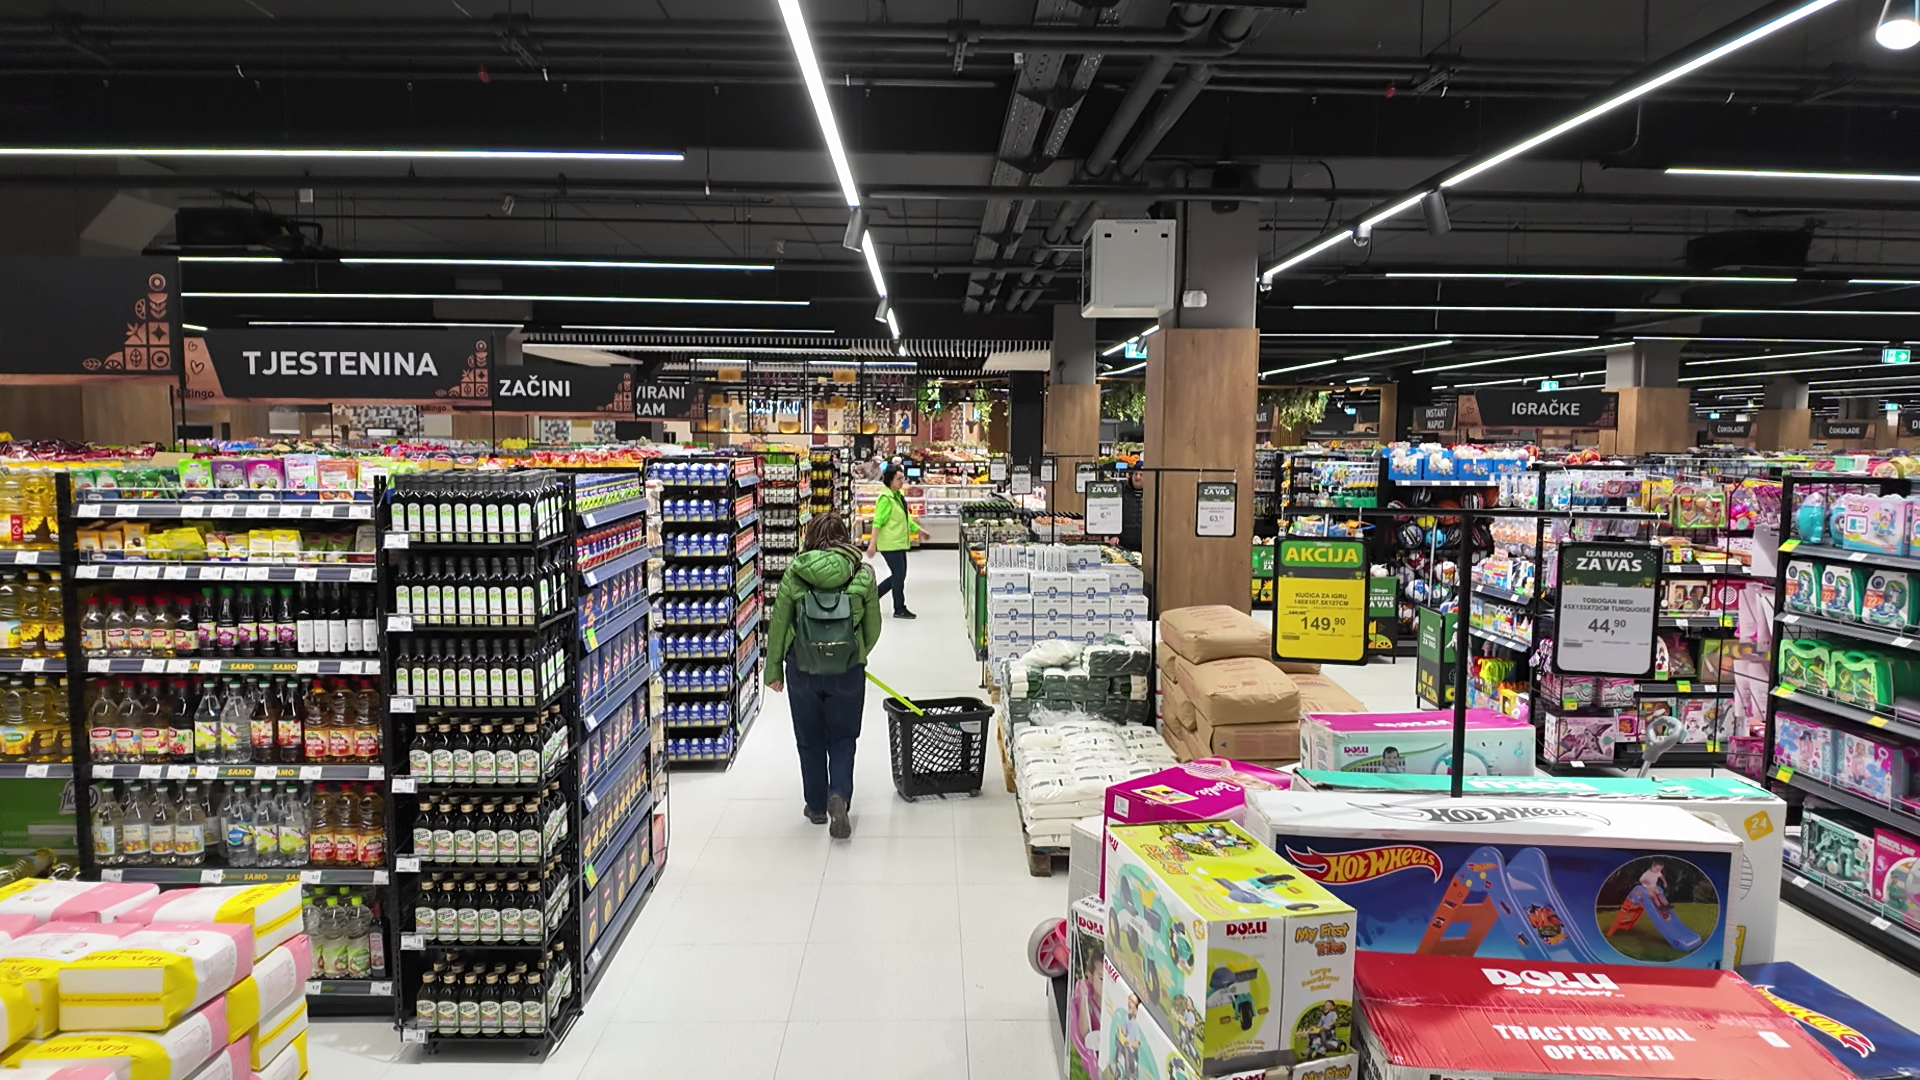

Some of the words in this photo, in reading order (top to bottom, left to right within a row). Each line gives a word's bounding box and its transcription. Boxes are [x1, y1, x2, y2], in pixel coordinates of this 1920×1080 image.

[242, 351, 438, 376] TJESTENINA
[499, 375, 571, 397] ZAČINI
[1425, 408, 1447, 418] INSTANT
[1511, 400, 1580, 416] IGRAČKE
[1427, 420, 1445, 430] NAPICI
[1285, 547, 1359, 563] AKCIJA
[1586, 550, 1634, 559] IZABRANO
[1576, 558, 1601, 571] ZA
[1605, 558, 1643, 572] VAS
[1611, 605, 1651, 613] TURQUOISE
[1588, 618, 1626, 636] 44,90
[230, 663, 255, 671] SAMO
[272, 663, 297, 671] SAMO
[227, 768, 251, 776] SAMO
[1195, 782, 1241, 797] Barbie
[1751, 817, 1768, 829] 24
[243, 873, 268, 881] SAMO
[1226, 921, 1267, 936] DOLU
[1295, 927, 1319, 944] My
[1320, 922, 1350, 940] First
[1315, 938, 1347, 957] Trike
[1310, 967, 1332, 977] Large
[1481, 967, 1621, 991] DOLU
[1493, 1024, 1613, 1042] TRACTOR
[1621, 1026, 1695, 1042] PEDAL
[1543, 1044, 1675, 1061] OPERATED
